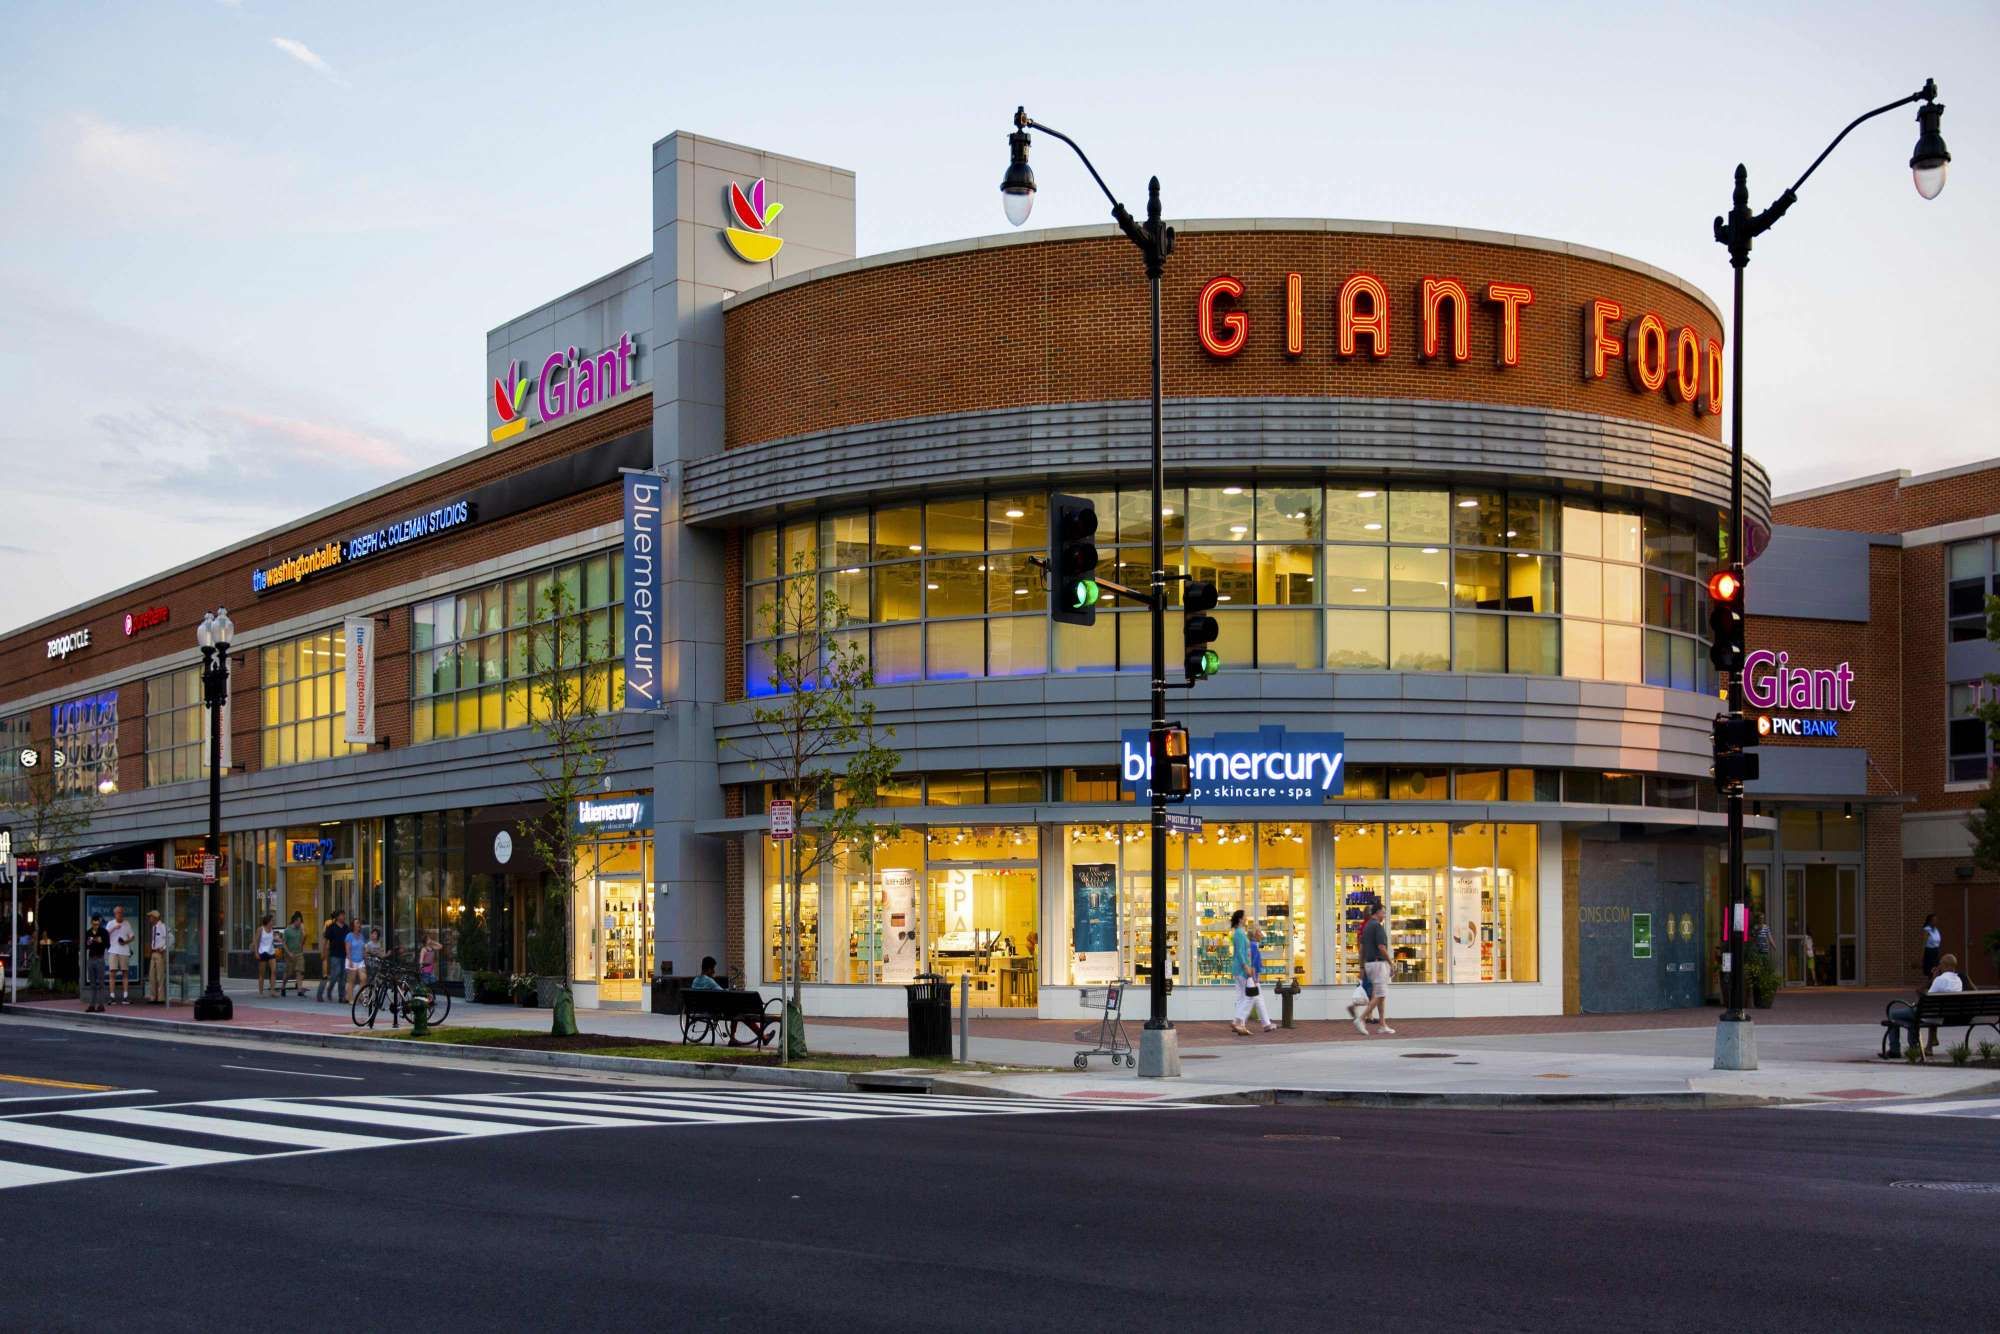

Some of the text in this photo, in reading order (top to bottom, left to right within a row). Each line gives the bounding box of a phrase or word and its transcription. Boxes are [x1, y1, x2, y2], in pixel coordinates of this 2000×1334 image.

[1198, 272, 1724, 415] GIANT FOOD
[538, 331, 637, 423] Giant
[348, 534, 378, 561] JOSEPH
[388, 513, 429, 544] COLEMAN
[429, 500, 469, 533] STUDIOS
[628, 483, 660, 700] bluemercury
[1743, 649, 1856, 712] Giant
[1124, 742, 1343, 790] blmercury
[1214, 785, 1276, 798] skincare
[1288, 786, 1312, 801] spa
[579, 801, 640, 825] bluemercury
[175, 854, 199, 871] WELLS
